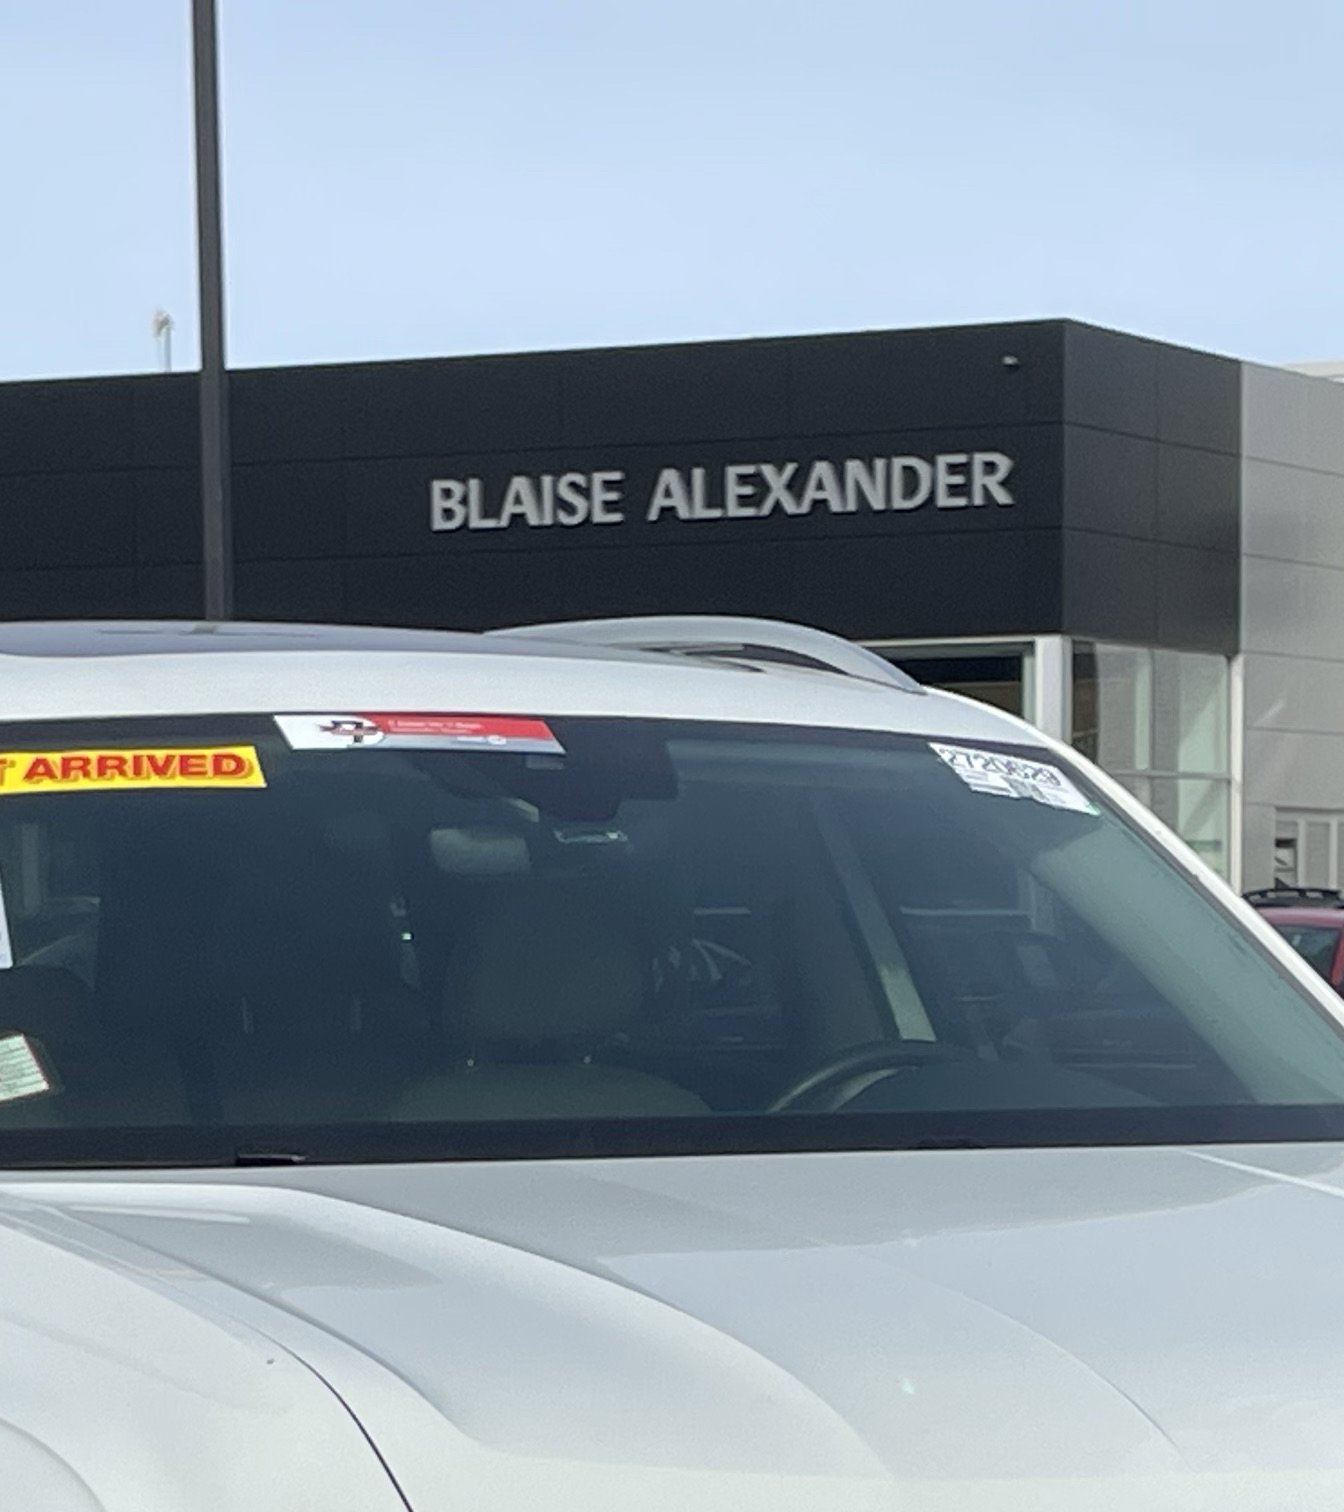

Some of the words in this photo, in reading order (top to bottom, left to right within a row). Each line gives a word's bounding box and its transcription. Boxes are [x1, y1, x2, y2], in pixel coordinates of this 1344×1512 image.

[430, 471, 625, 531] BLAISE
[645, 451, 1015, 523] ALEXANDER
[23, 753, 254, 784] ARRIVED
